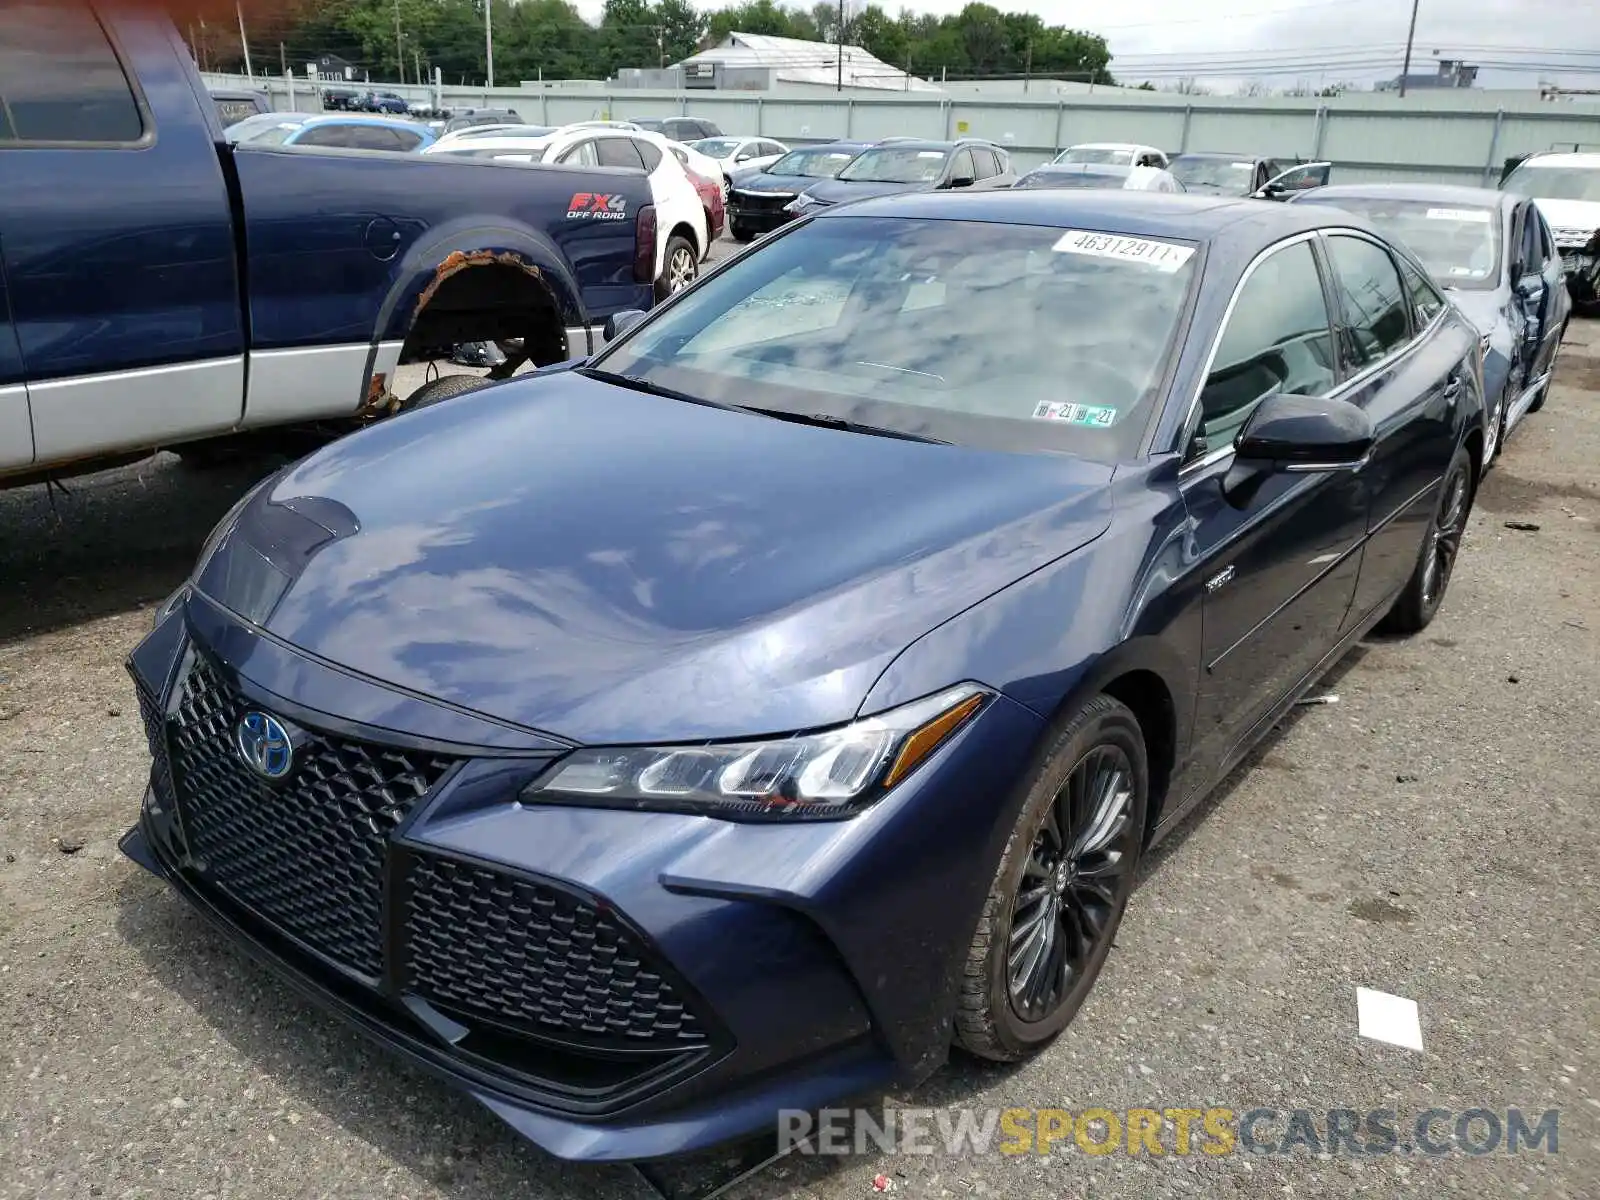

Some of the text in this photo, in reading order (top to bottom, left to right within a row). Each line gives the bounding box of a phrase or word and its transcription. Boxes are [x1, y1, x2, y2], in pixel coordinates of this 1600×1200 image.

[568, 192, 626, 212] FX4
[566, 211, 626, 220] OFF ROAD
